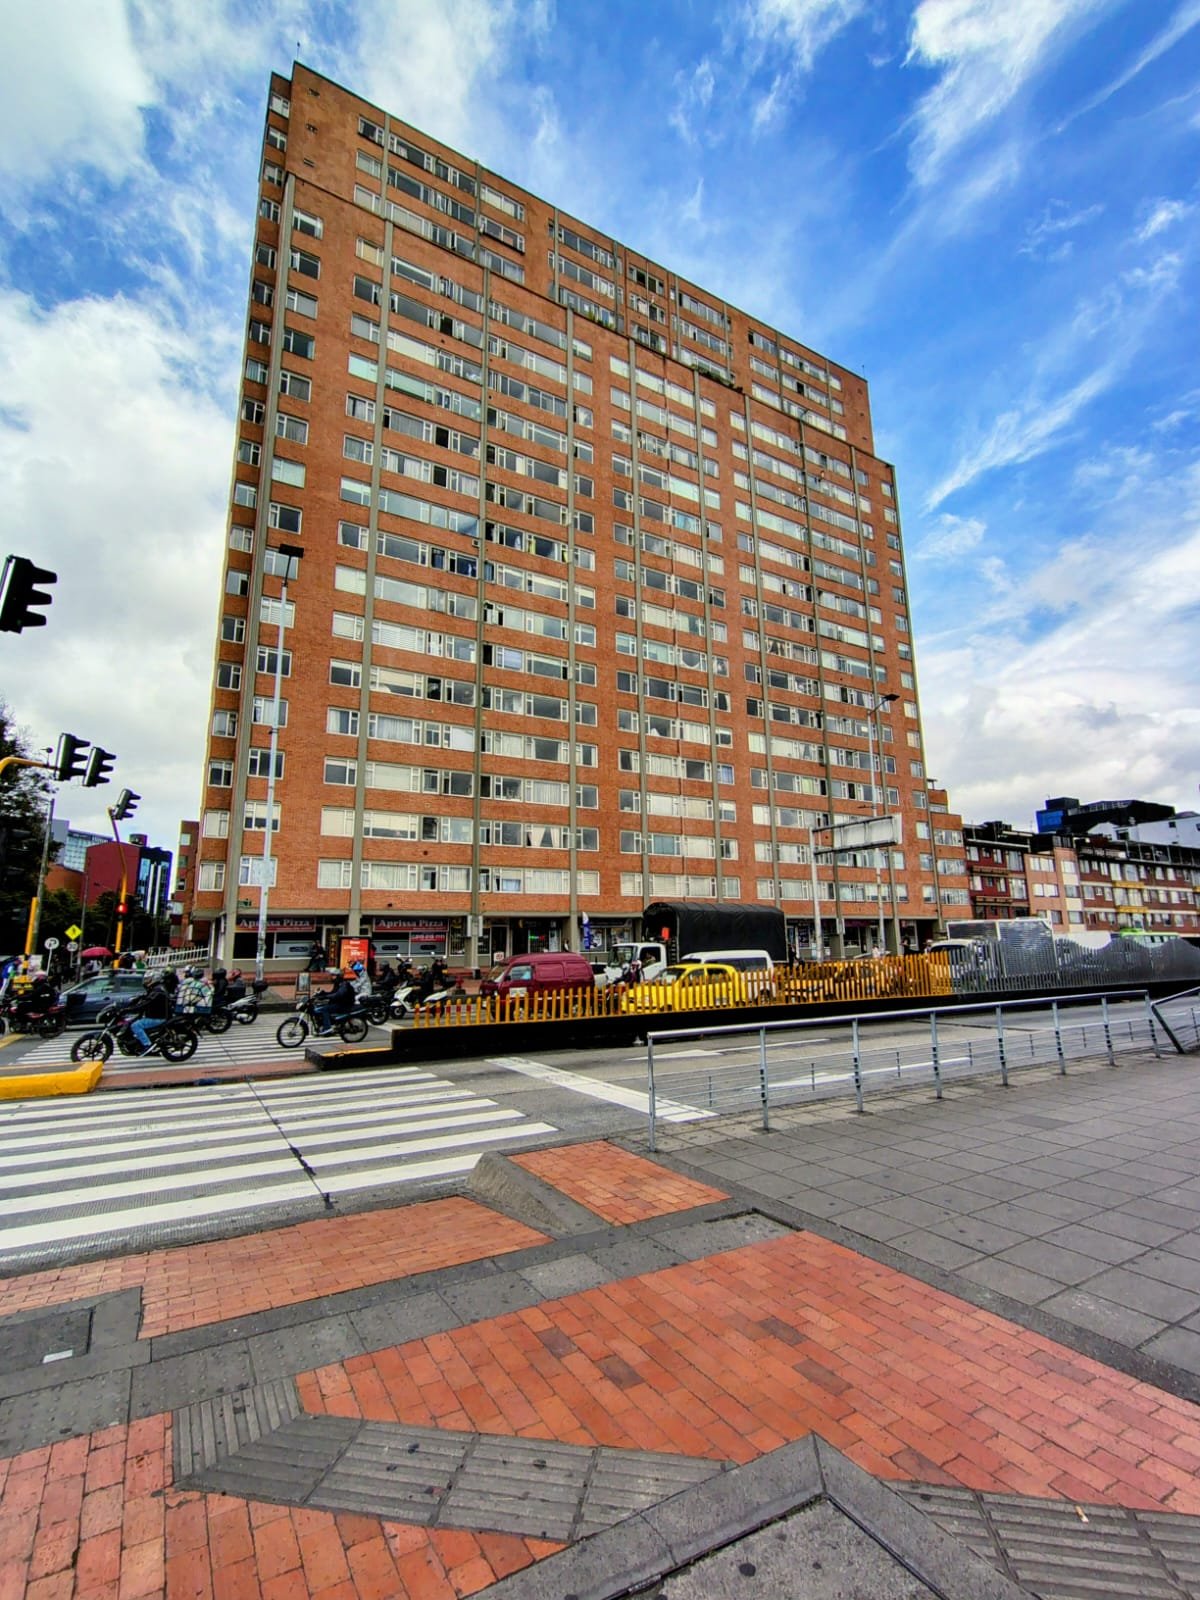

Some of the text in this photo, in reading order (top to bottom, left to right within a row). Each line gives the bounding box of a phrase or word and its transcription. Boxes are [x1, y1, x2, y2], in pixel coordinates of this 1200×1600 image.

[283, 919, 310, 927] Pizza
[379, 919, 443, 928] Aprissa Pizza
